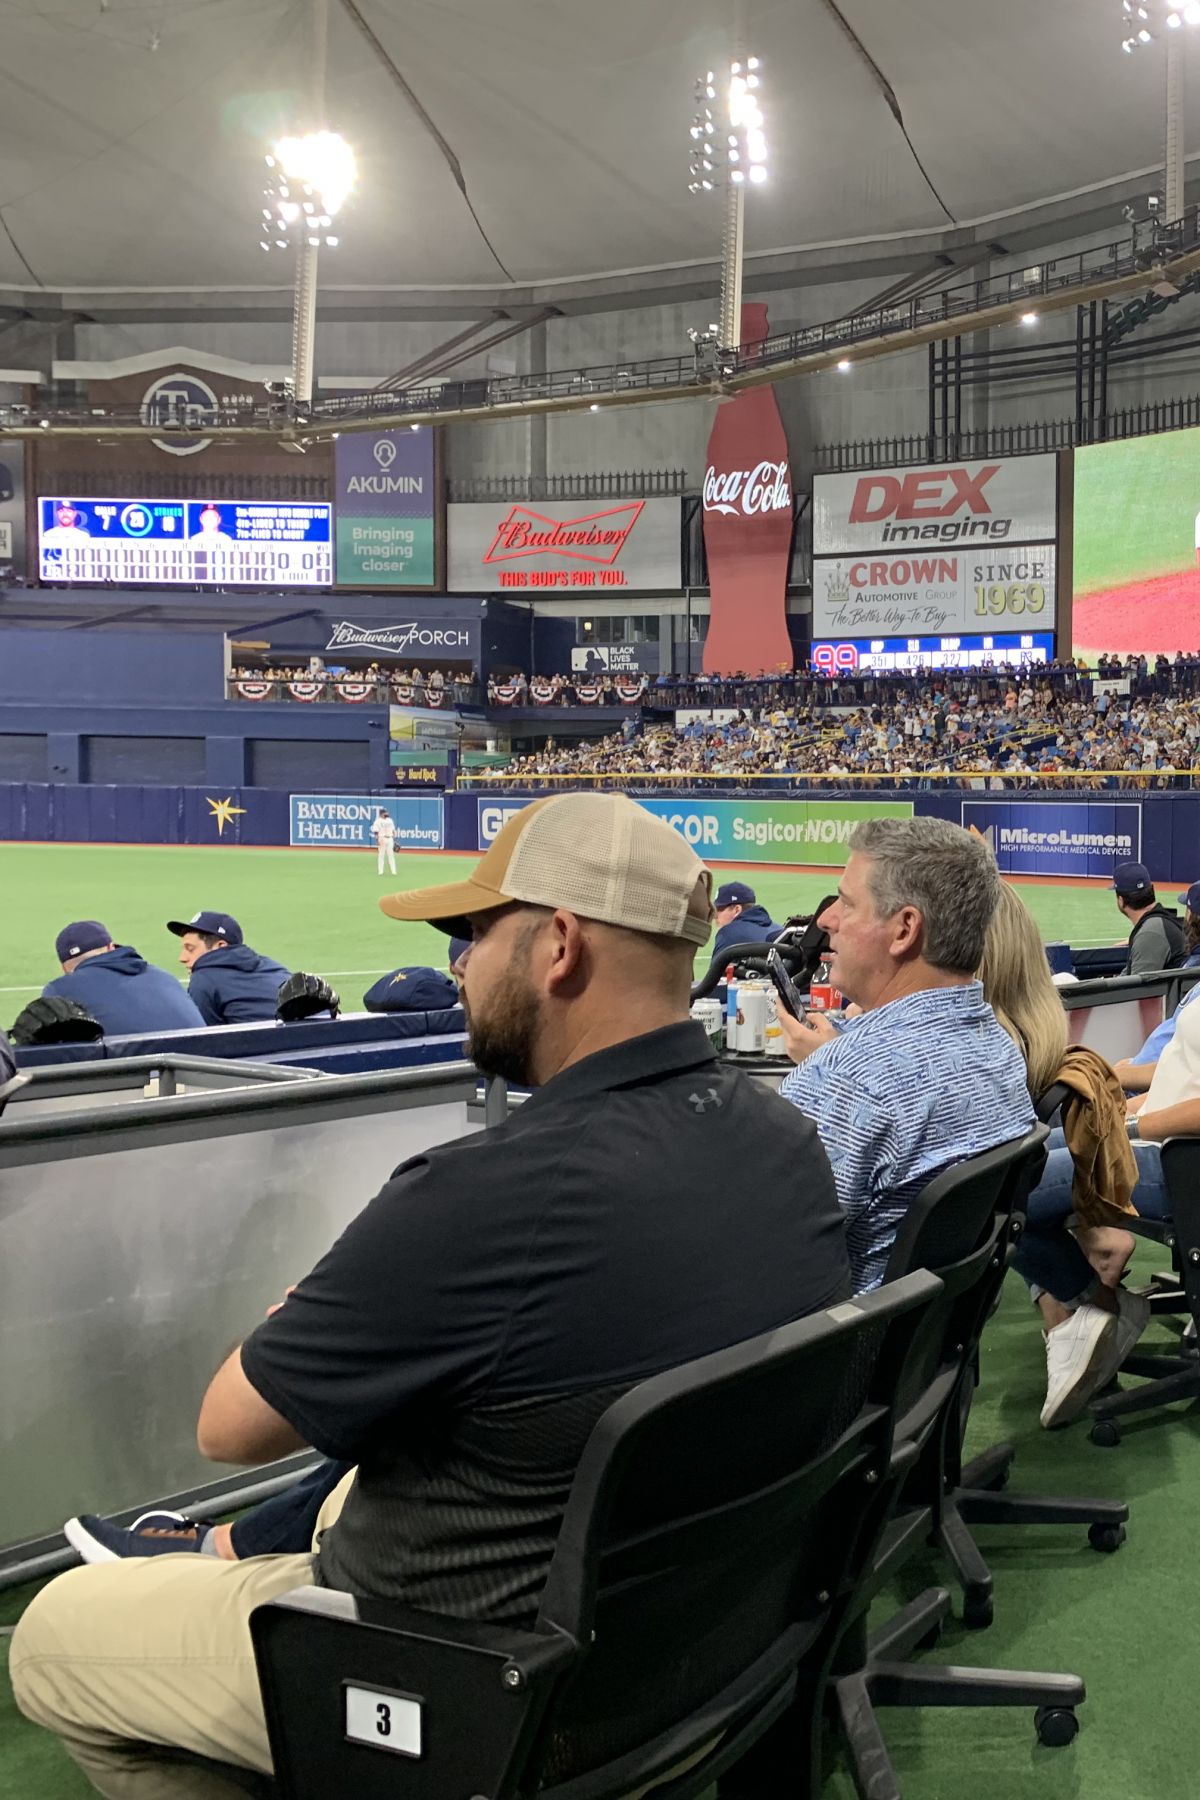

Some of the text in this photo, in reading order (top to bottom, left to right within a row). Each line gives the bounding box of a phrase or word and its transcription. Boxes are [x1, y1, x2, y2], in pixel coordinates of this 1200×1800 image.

[346, 476, 423, 494] AKUMIN
[703, 460, 791, 516] Coca-Cola
[848, 465, 1002, 524] DEX
[352, 526, 415, 544] Bringing
[498, 521, 627, 548] Budweiser
[882, 516, 1012, 542] imaging
[353, 542, 413, 560] Imaging
[362, 558, 405, 573] closer
[850, 558, 1044, 588] CROWN SINCE
[499, 570, 628, 587] THIS BUD'S FOR YOU.
[925, 589, 958, 600] GROUP
[974, 582, 1045, 616] 1969
[825, 603, 946, 631] The Better Way To Buy
[334, 628, 469, 645] Budweiser PORCH
[610, 647, 634, 655] BLACK
[814, 644, 857, 677] 99
[610, 663, 639, 671] MATTER
[408, 768, 422, 780] Hard
[297, 801, 384, 820] BAYFRONT
[297, 821, 363, 840] HEALTH
[1000, 828, 1132, 847] MicroLumen
[1000, 844, 1131, 856] HIGH PERFORMANCE MEDICAL DEVICES
[376, 1703, 391, 1736] 3
